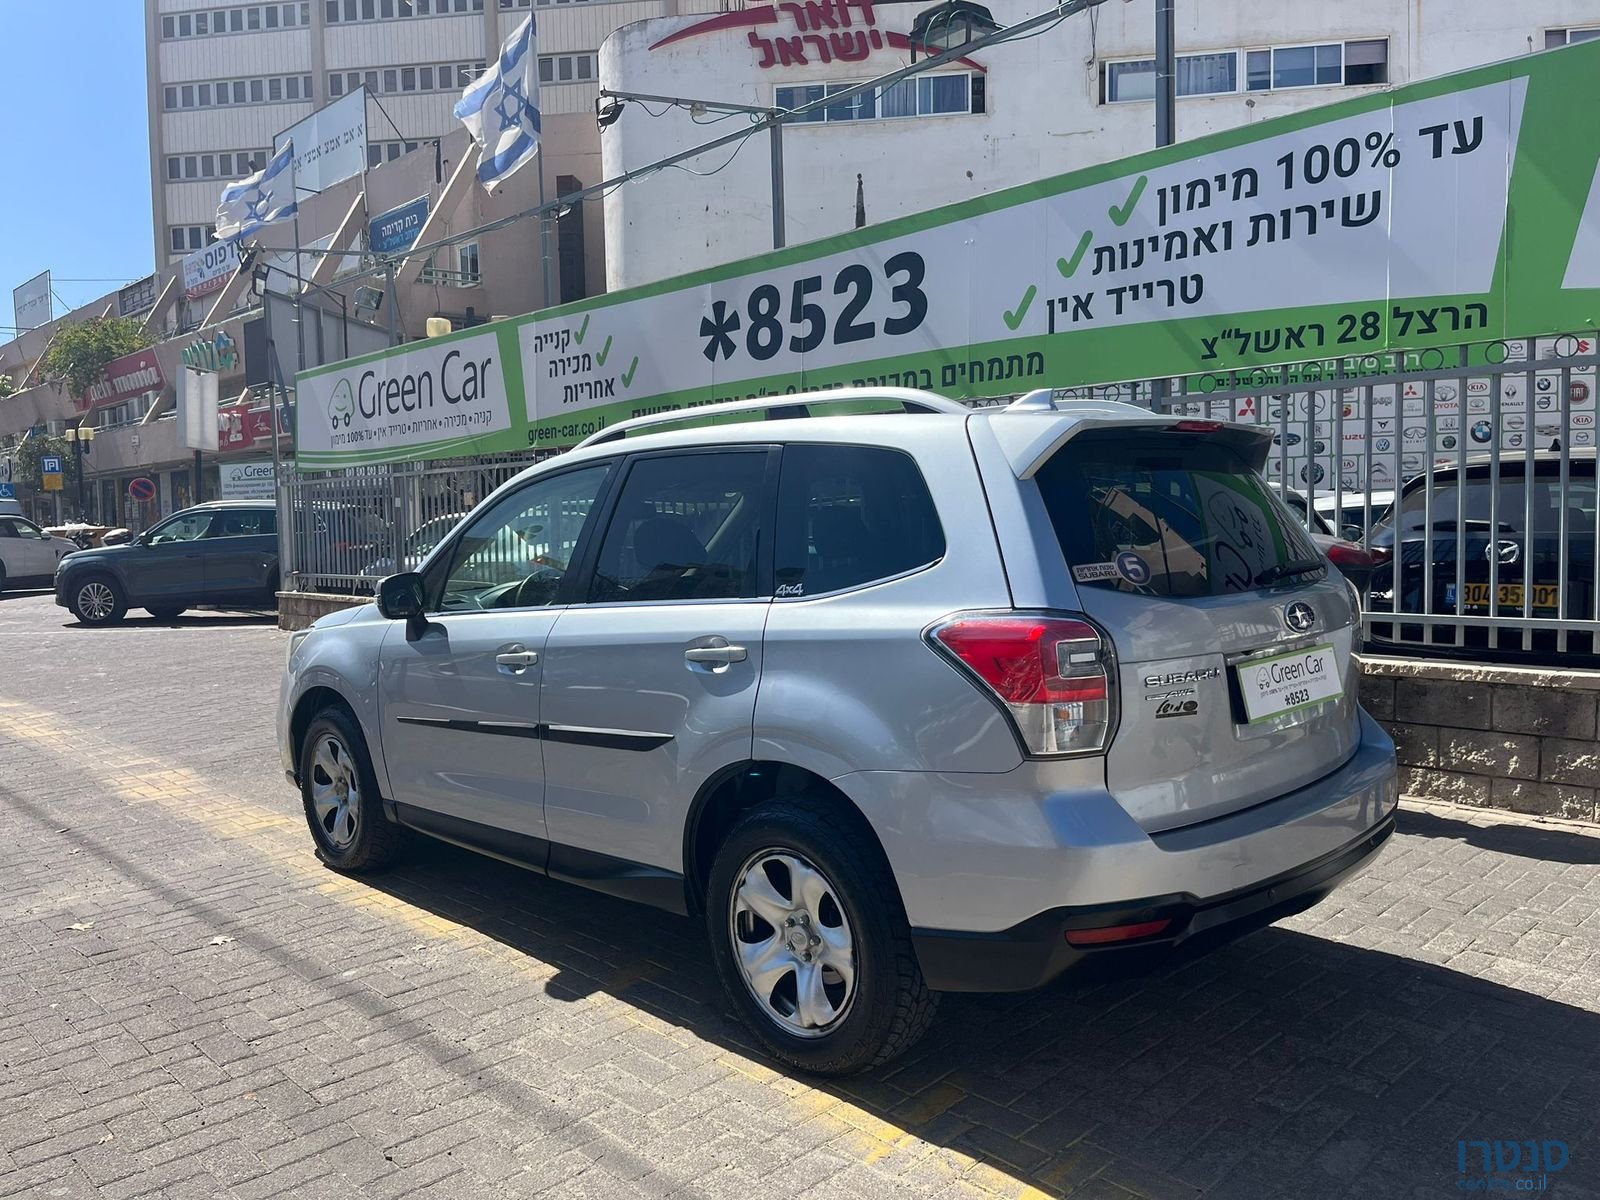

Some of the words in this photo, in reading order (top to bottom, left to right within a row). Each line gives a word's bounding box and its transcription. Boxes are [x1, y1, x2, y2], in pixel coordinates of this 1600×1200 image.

[779, 0, 875, 31] דואר
[748, 29, 883, 68] ישראל
[1418, 116, 1484, 159] עד
[1276, 131, 1401, 190] 100%
[1157, 167, 1259, 227] מימון
[381, 219, 403, 238] קדימה
[405, 214, 418, 228] בית
[1247, 190, 1382, 247] שירות
[205, 242, 235, 270] דפוס
[1092, 220, 1233, 276] ואמינות
[1106, 273, 1205, 316] טרייד
[1046, 290, 1096, 334] אין
[1393, 301, 1489, 337] הרצל
[534, 328, 571, 353] קנייה
[1337, 312, 1382, 345] 28
[113, 361, 160, 393] mania
[549, 352, 592, 378] מכירה
[942, 352, 1045, 388] מתמחים
[358, 369, 433, 419] Green
[441, 349, 492, 404] Car
[563, 378, 615, 403] אחריות
[388, 423, 406, 435] טרייד
[412, 418, 438, 433] אחריות
[443, 414, 467, 428] מכירה
[473, 410, 492, 426] קניה
[528, 416, 605, 445] green-car.co.il
[347, 430, 364, 443] 100%
[364, 430, 373, 440] עד
[377, 426, 387, 441] אין
[1078, 570, 1118, 580] SUBARU
[1123, 556, 1145, 582] 5
[775, 583, 804, 596] 4x4
[1145, 667, 1220, 688] SUBARU
[1271, 662, 1305, 684] Green
[1305, 655, 1323, 675] Car
